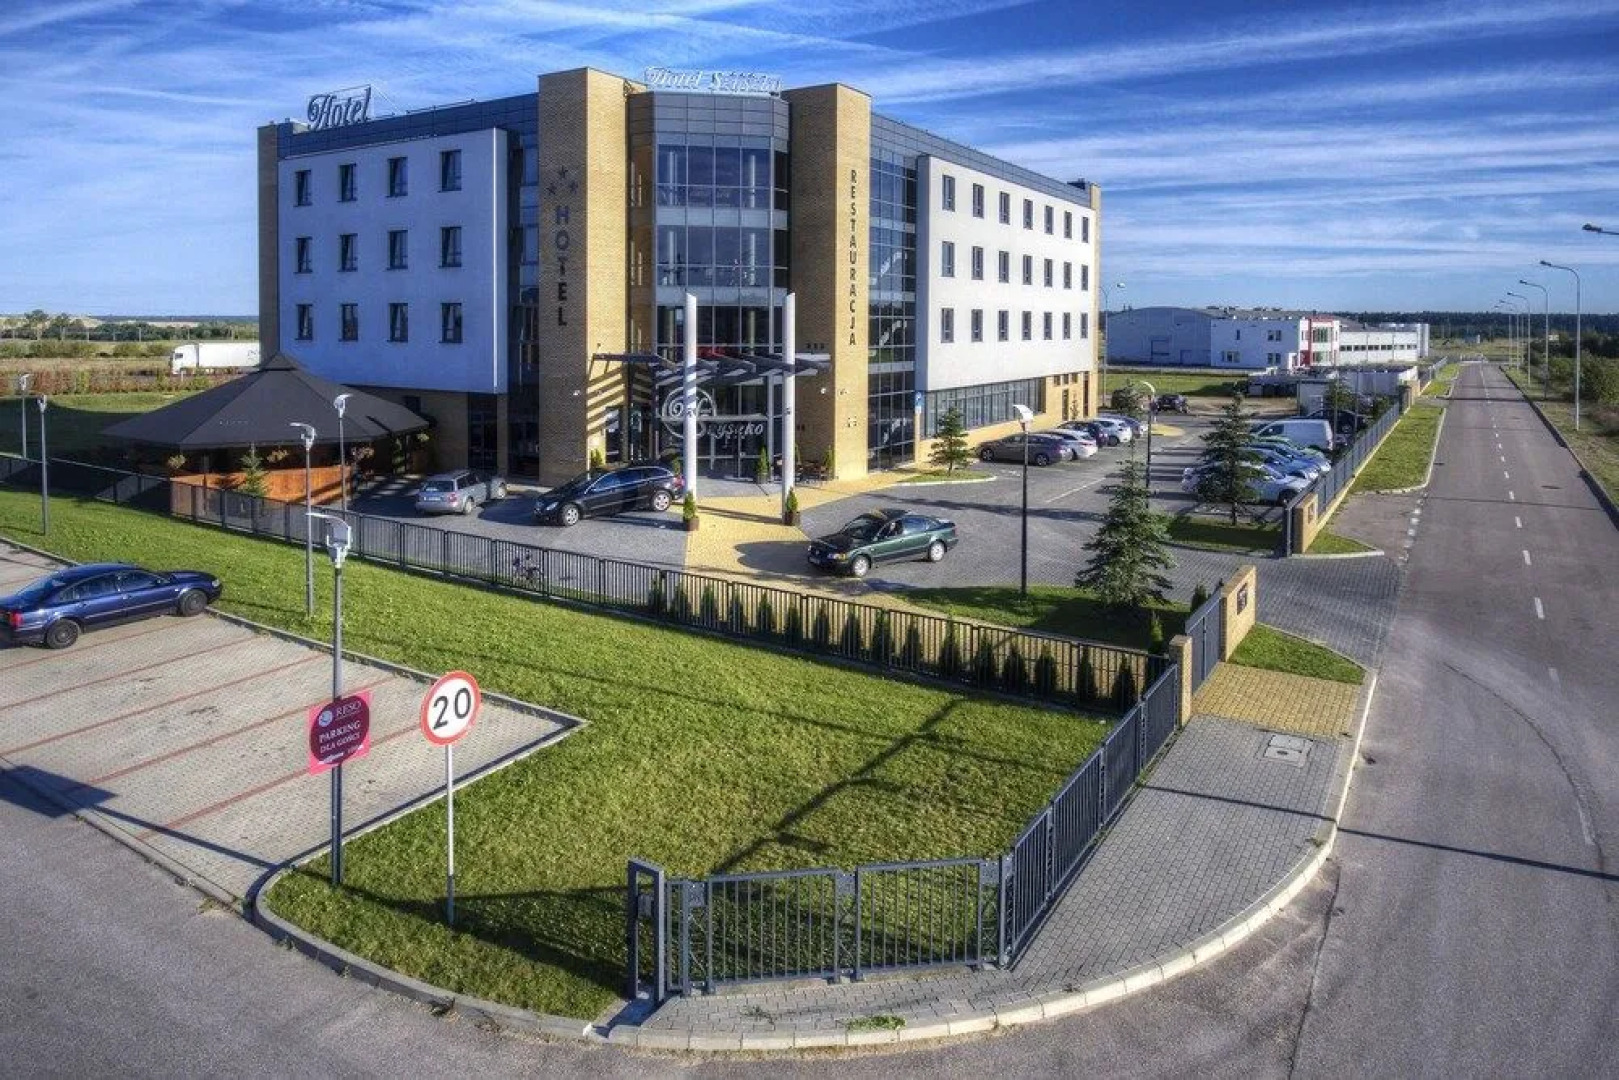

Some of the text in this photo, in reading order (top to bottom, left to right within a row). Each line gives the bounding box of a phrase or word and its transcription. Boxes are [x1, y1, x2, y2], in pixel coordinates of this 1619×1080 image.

[307, 86, 371, 130] Hotel
[555, 205, 570, 326] HOTEL
[433, 687, 471, 730] 20
[318, 720, 361, 742] PARKING
